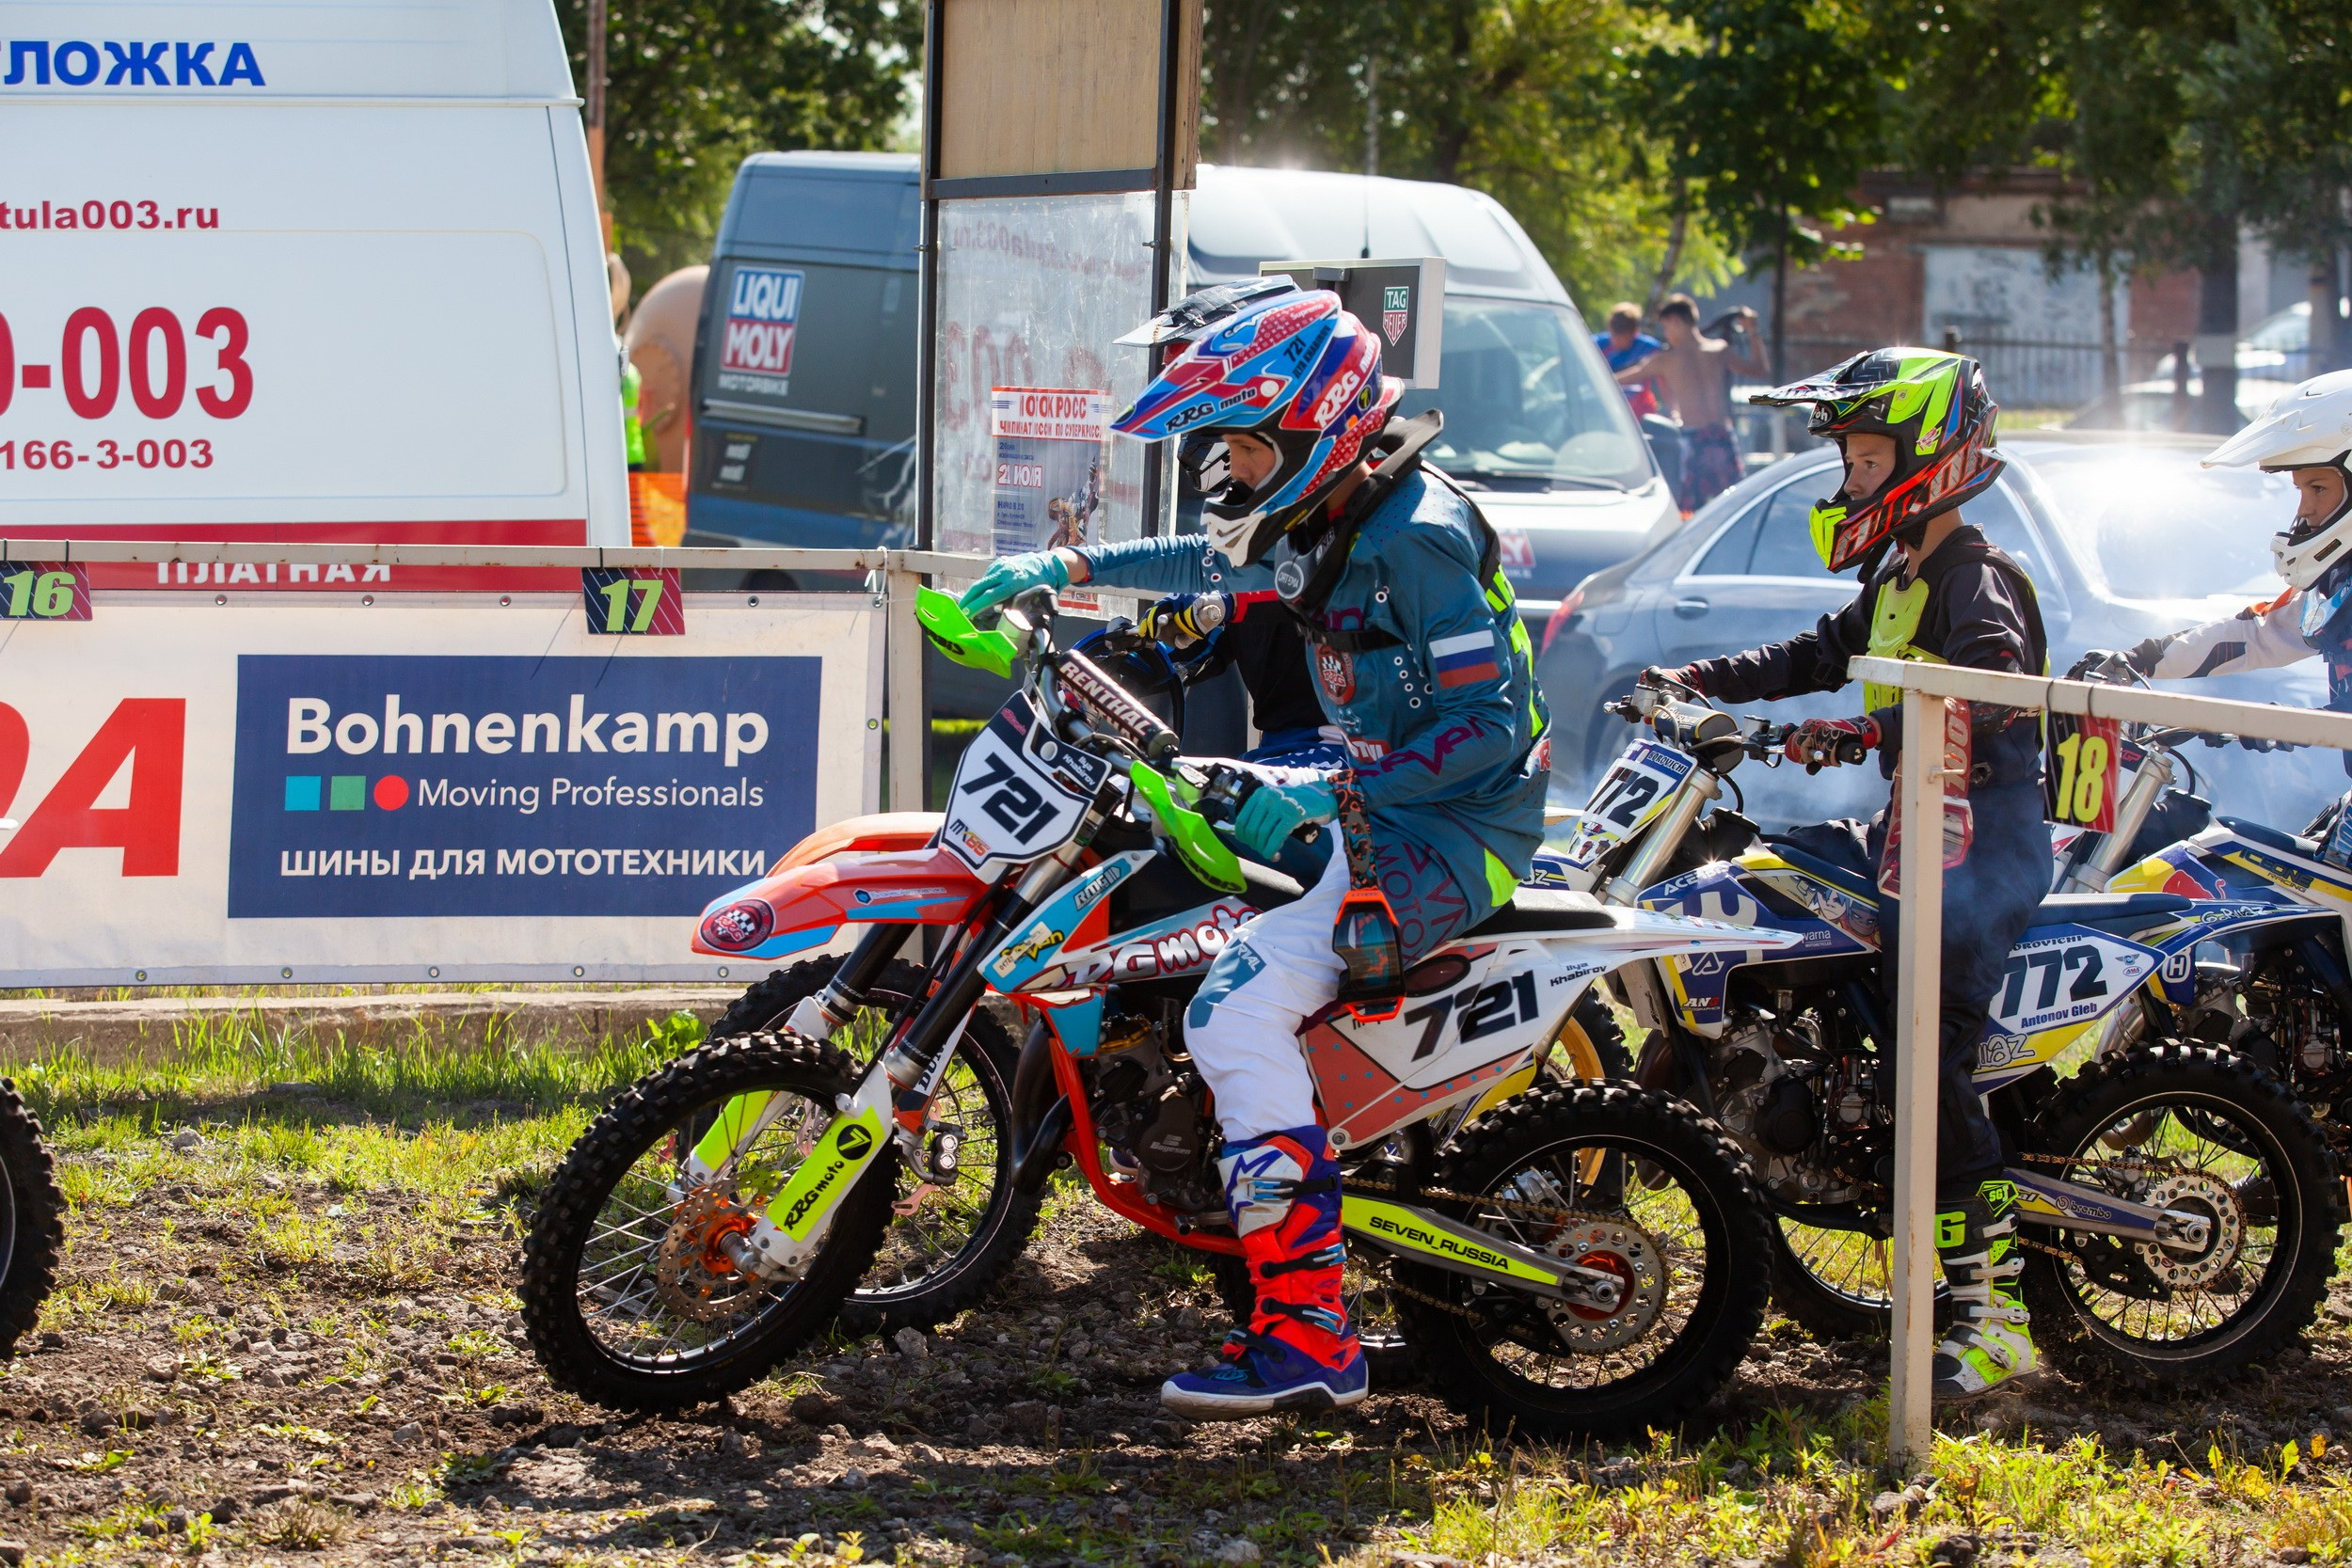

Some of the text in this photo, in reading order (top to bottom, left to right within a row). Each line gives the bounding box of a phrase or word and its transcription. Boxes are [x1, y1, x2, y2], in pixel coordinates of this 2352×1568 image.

[0, 40, 266, 87] ЛОЖКА
[732, 272, 800, 320] LIQUI
[1386, 290, 1407, 309] TAG
[724, 322, 794, 371] MOLY
[1384, 312, 1407, 341] HEUER
[0, 306, 253, 420] -003
[1283, 335, 1308, 362] 721
[1219, 387, 1257, 410] moto
[3, 570, 76, 617] 16
[601, 578, 665, 633] 17
[1058, 660, 1152, 737] RENTHAL
[288, 693, 770, 768] Bohnenkamp
[1646, 750, 1689, 775] BOROVICHI
[2056, 732, 2109, 823] 18
[417, 776, 765, 816] Moving Professionals
[960, 751, 1061, 847] 721
[279, 848, 767, 881] ШИНЫ ДЛЯ МОТОТЕХНИКИ
[2238, 847, 2314, 889] ICEONE
[2266, 872, 2307, 893] RACING
[1549, 965, 1607, 988] Khabirov
[1565, 962, 1588, 972] Ilya
[1405, 969, 1540, 1063] 721
[2020, 1002, 2098, 1029] Antonov Gleb
[2070, 1199, 2112, 1220] brembo
